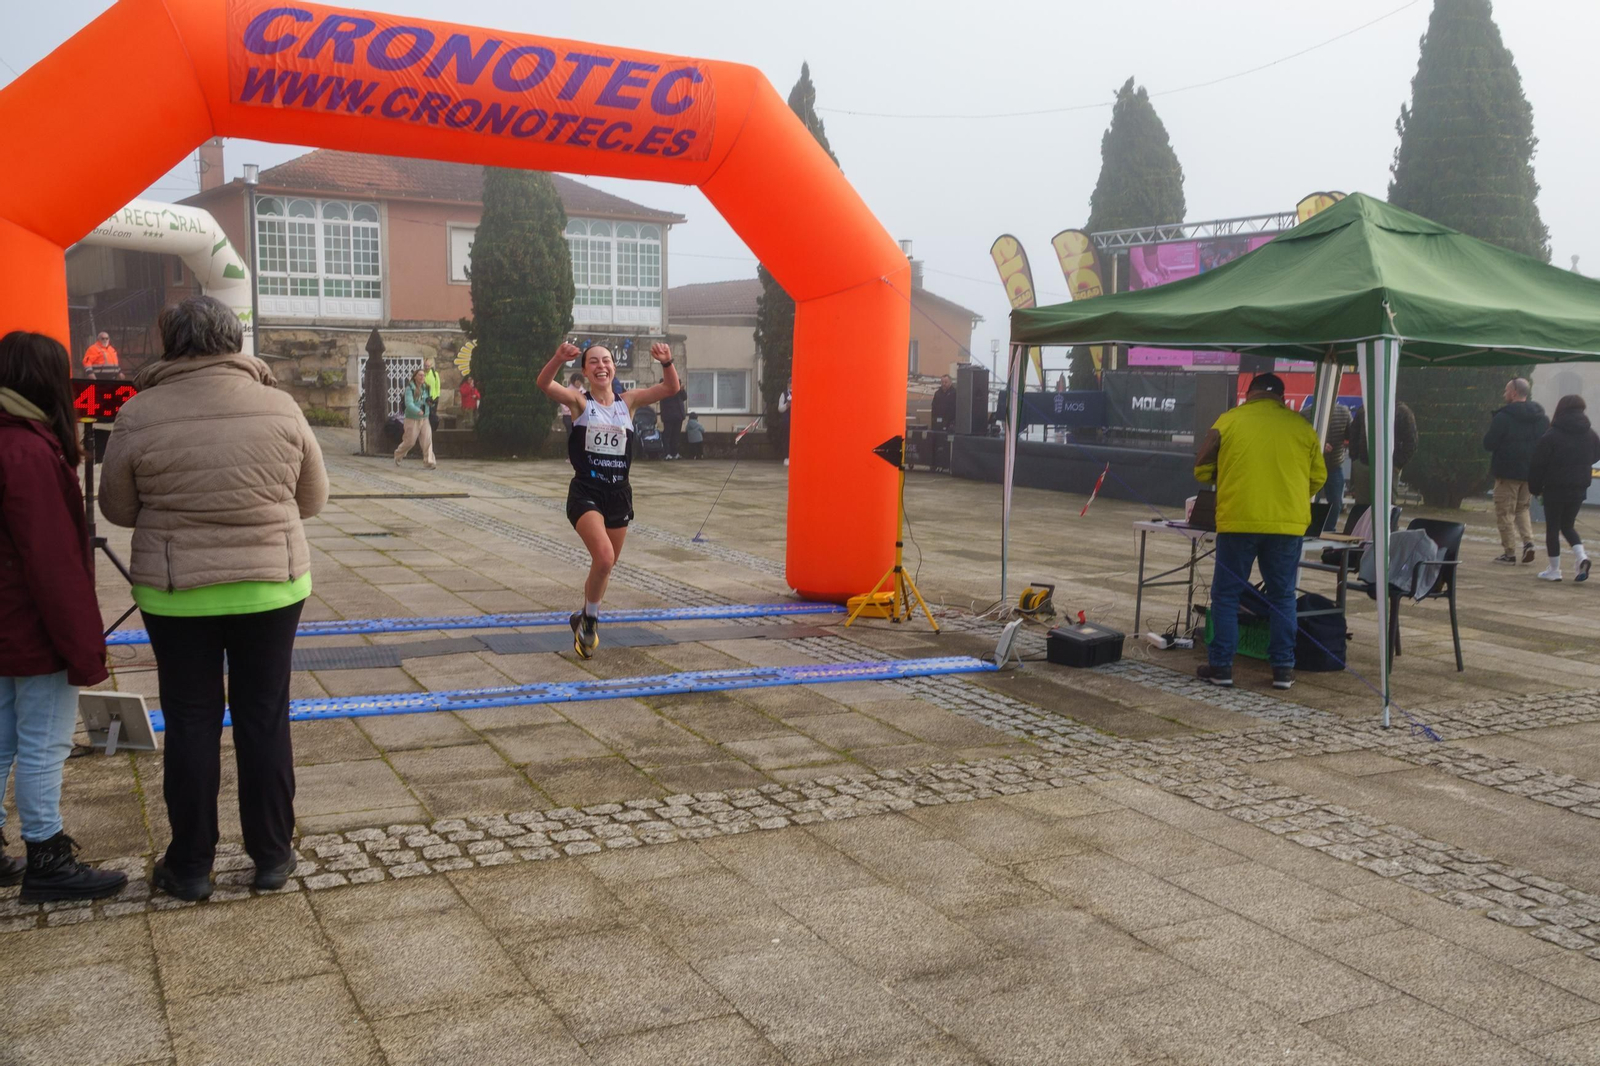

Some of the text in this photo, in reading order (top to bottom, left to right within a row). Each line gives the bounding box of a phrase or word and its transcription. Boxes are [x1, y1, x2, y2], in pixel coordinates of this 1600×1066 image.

[243, 7, 704, 116] CRONOTEC
[241, 66, 697, 157] WWW.CRONOTEC.ES
[1064, 401, 1085, 412] MOS
[1131, 396, 1176, 412] MOLIS
[594, 432, 619, 447] 616
[297, 699, 424, 712] CRONOTEC
